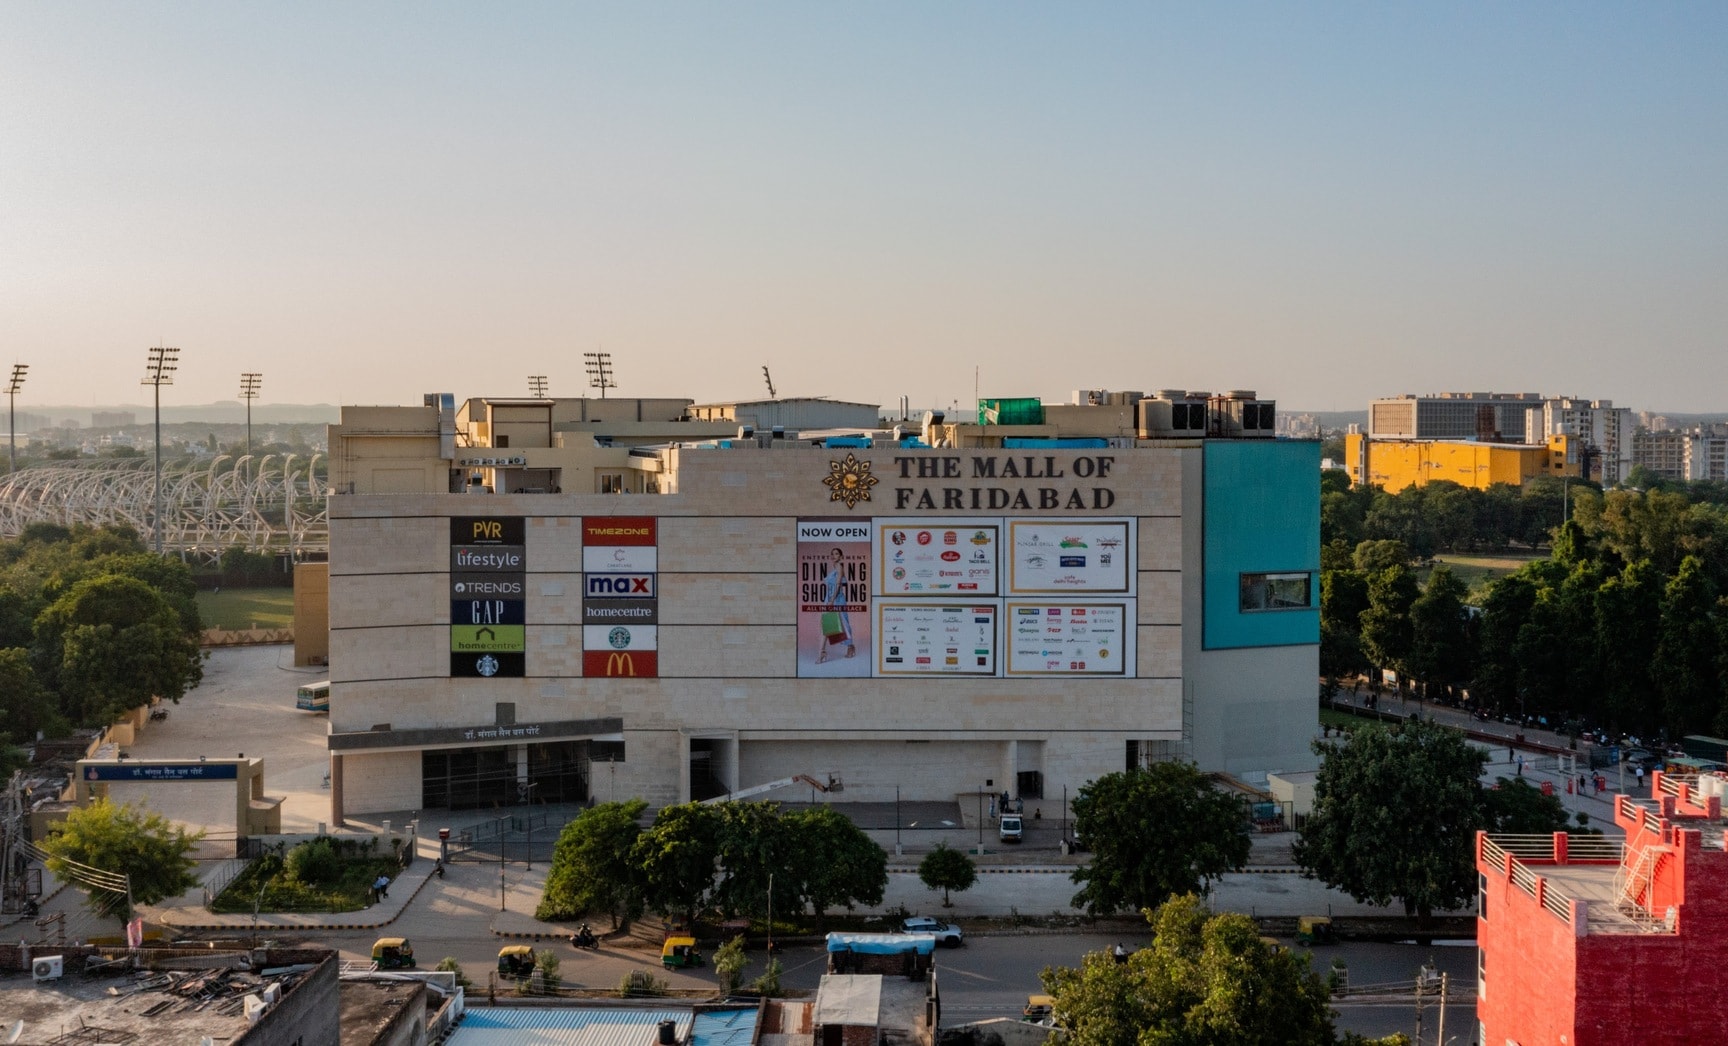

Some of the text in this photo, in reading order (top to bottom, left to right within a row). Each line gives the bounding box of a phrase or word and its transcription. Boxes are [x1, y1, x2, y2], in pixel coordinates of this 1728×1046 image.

[895, 456, 1114, 478] THE MALL OF
[895, 488, 1114, 510] FARIDABAD
[474, 520, 502, 538] PVR
[802, 528, 867, 536] NOW OPEN
[458, 549, 519, 568] lifestyle
[802, 562, 866, 581] DINNG
[466, 582, 520, 593] TRENDS
[590, 578, 649, 593] max
[802, 584, 866, 602] SHOING
[472, 600, 504, 624] GAP
[586, 607, 652, 616] homecentre
